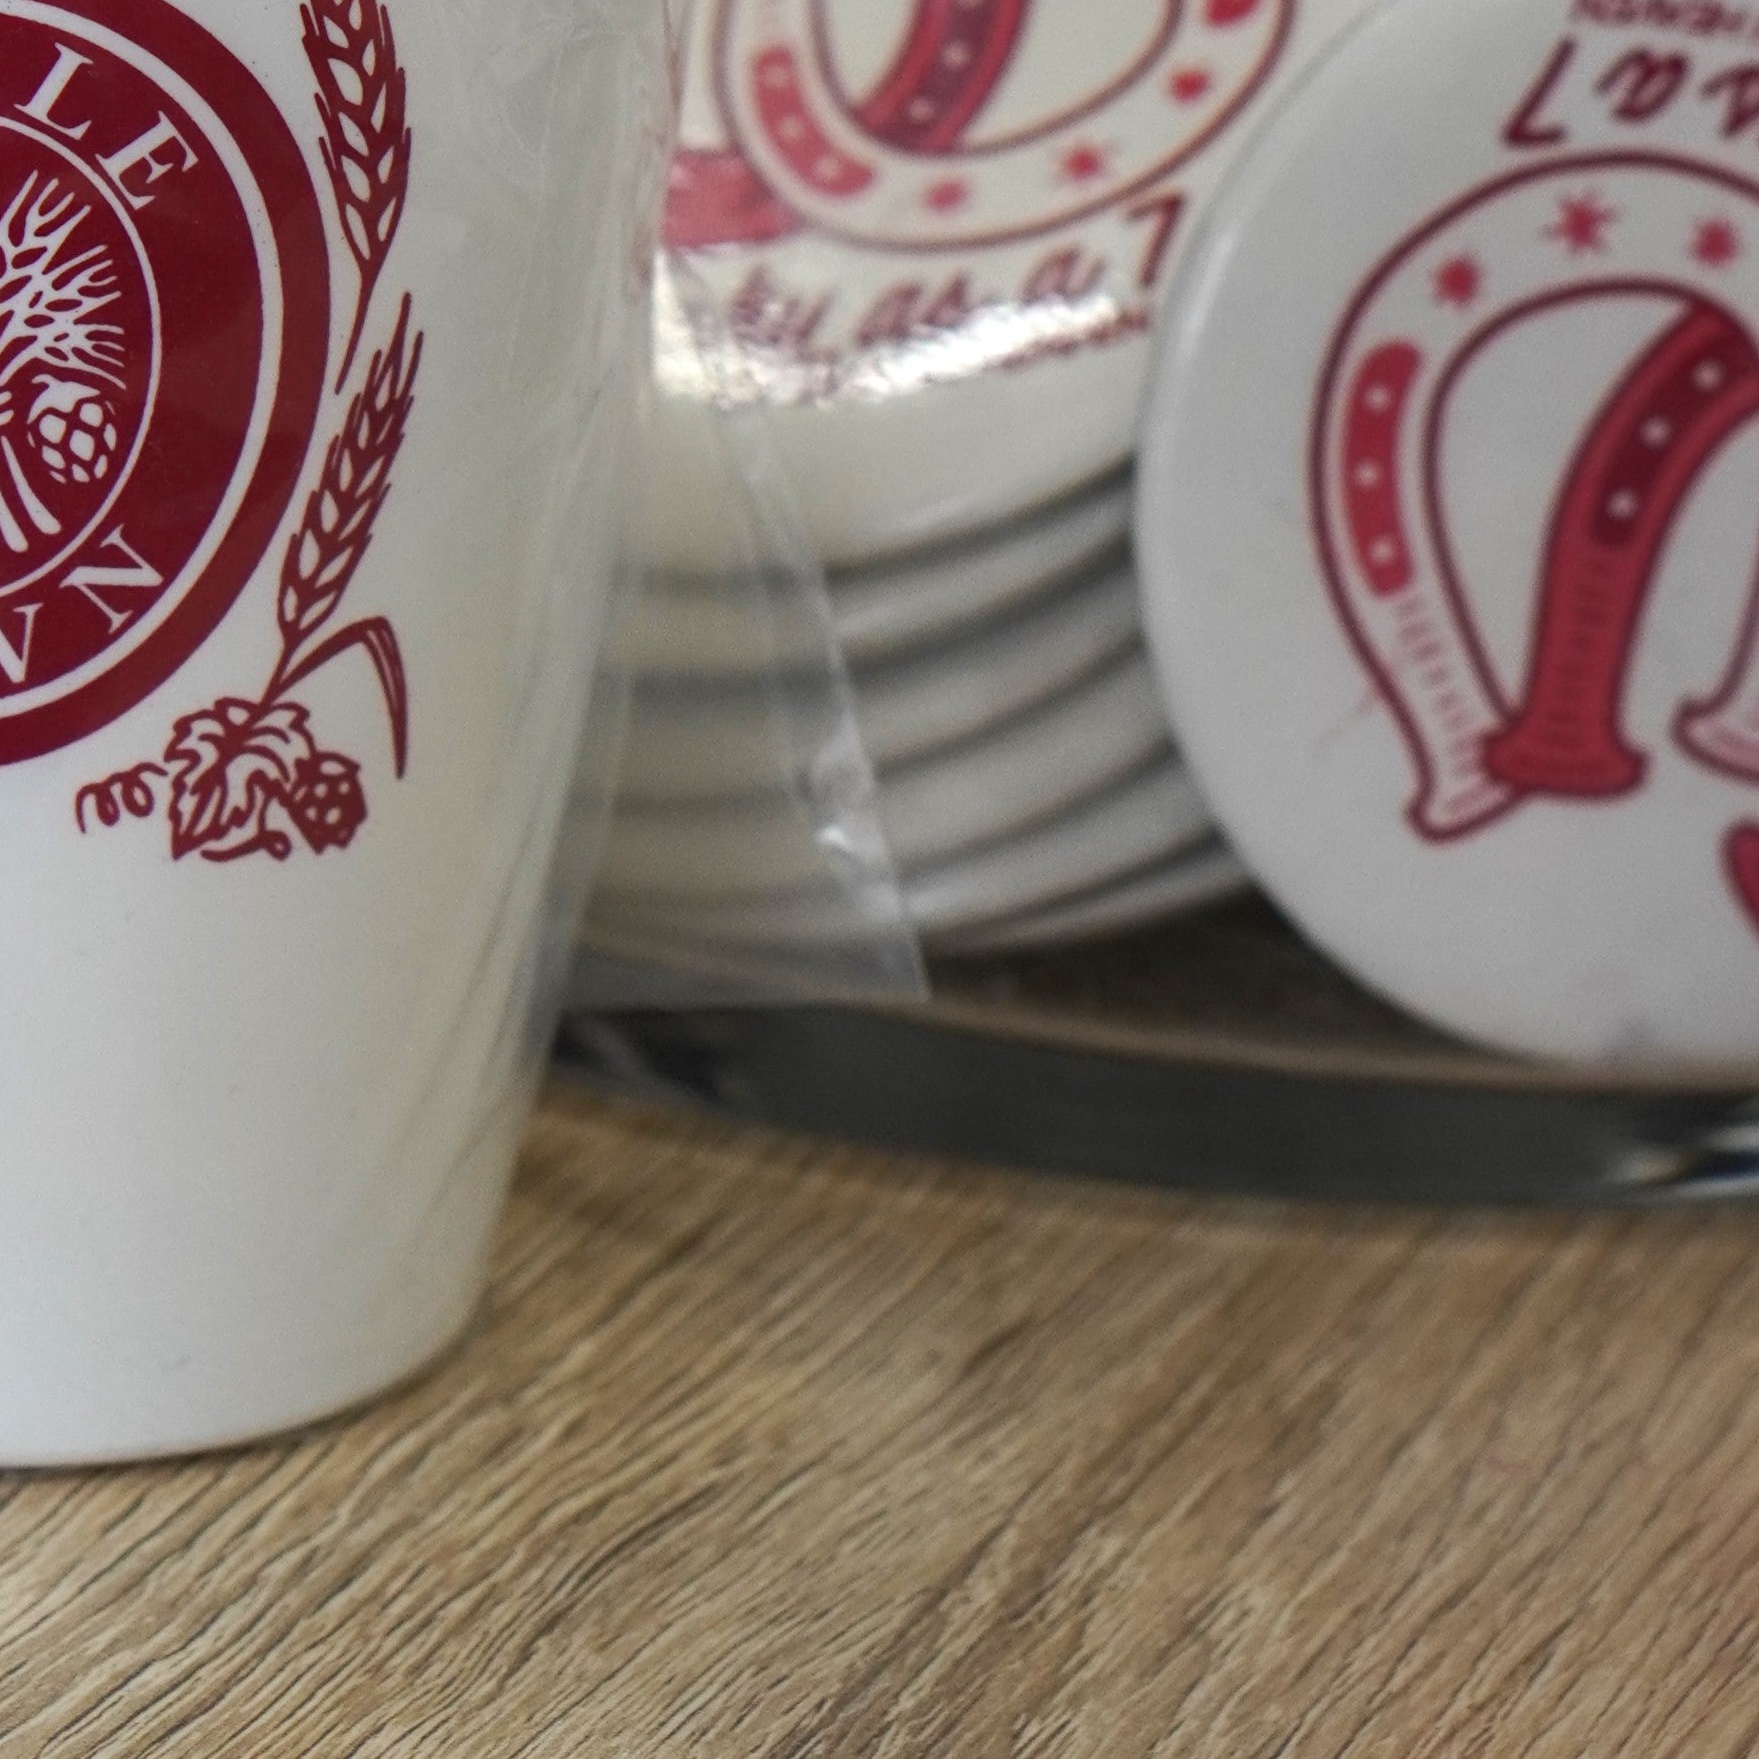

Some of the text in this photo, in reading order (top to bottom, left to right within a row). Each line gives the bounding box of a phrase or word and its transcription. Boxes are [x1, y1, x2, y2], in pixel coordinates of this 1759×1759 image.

[1503, 37, 1577, 147] 7
[1596, 47, 1690, 124] a
[1129, 191, 1186, 288] 7
